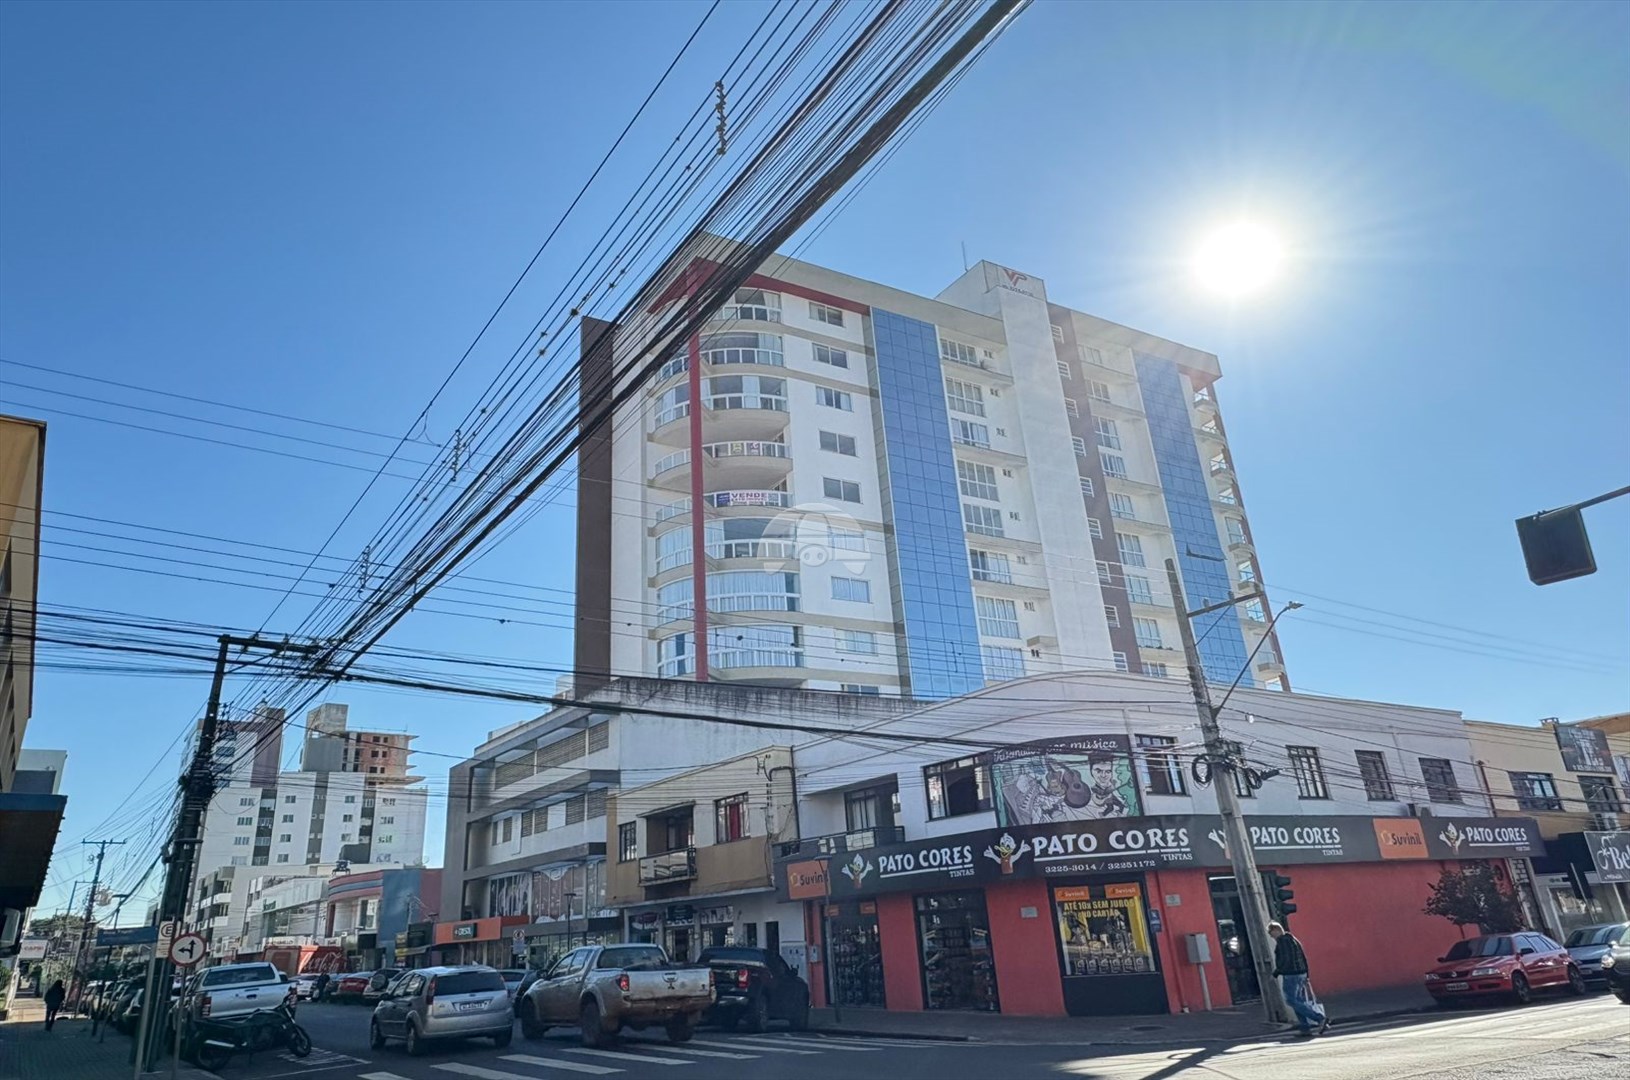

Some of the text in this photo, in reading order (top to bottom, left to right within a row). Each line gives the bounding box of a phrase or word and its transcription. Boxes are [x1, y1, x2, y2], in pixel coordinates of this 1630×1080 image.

[1070, 738, 1118, 750] música
[1250, 826, 1340, 844] PATO CORES
[1391, 832, 1422, 846] Suvinil
[1465, 827, 1528, 842] PATO CORES
[1032, 828, 1190, 856] PATO CORES
[878, 845, 973, 873] PATO CORES
[1161, 852, 1193, 861] TINTAS
[949, 868, 975, 878] TINTAS
[1045, 863, 1097, 873] 3225-3014
[1107, 860, 1156, 870] 32251172
[1064, 901, 1078, 911] ATÉ
[1092, 900, 1109, 909] SEM
[1110, 899, 1135, 908] JUROS
